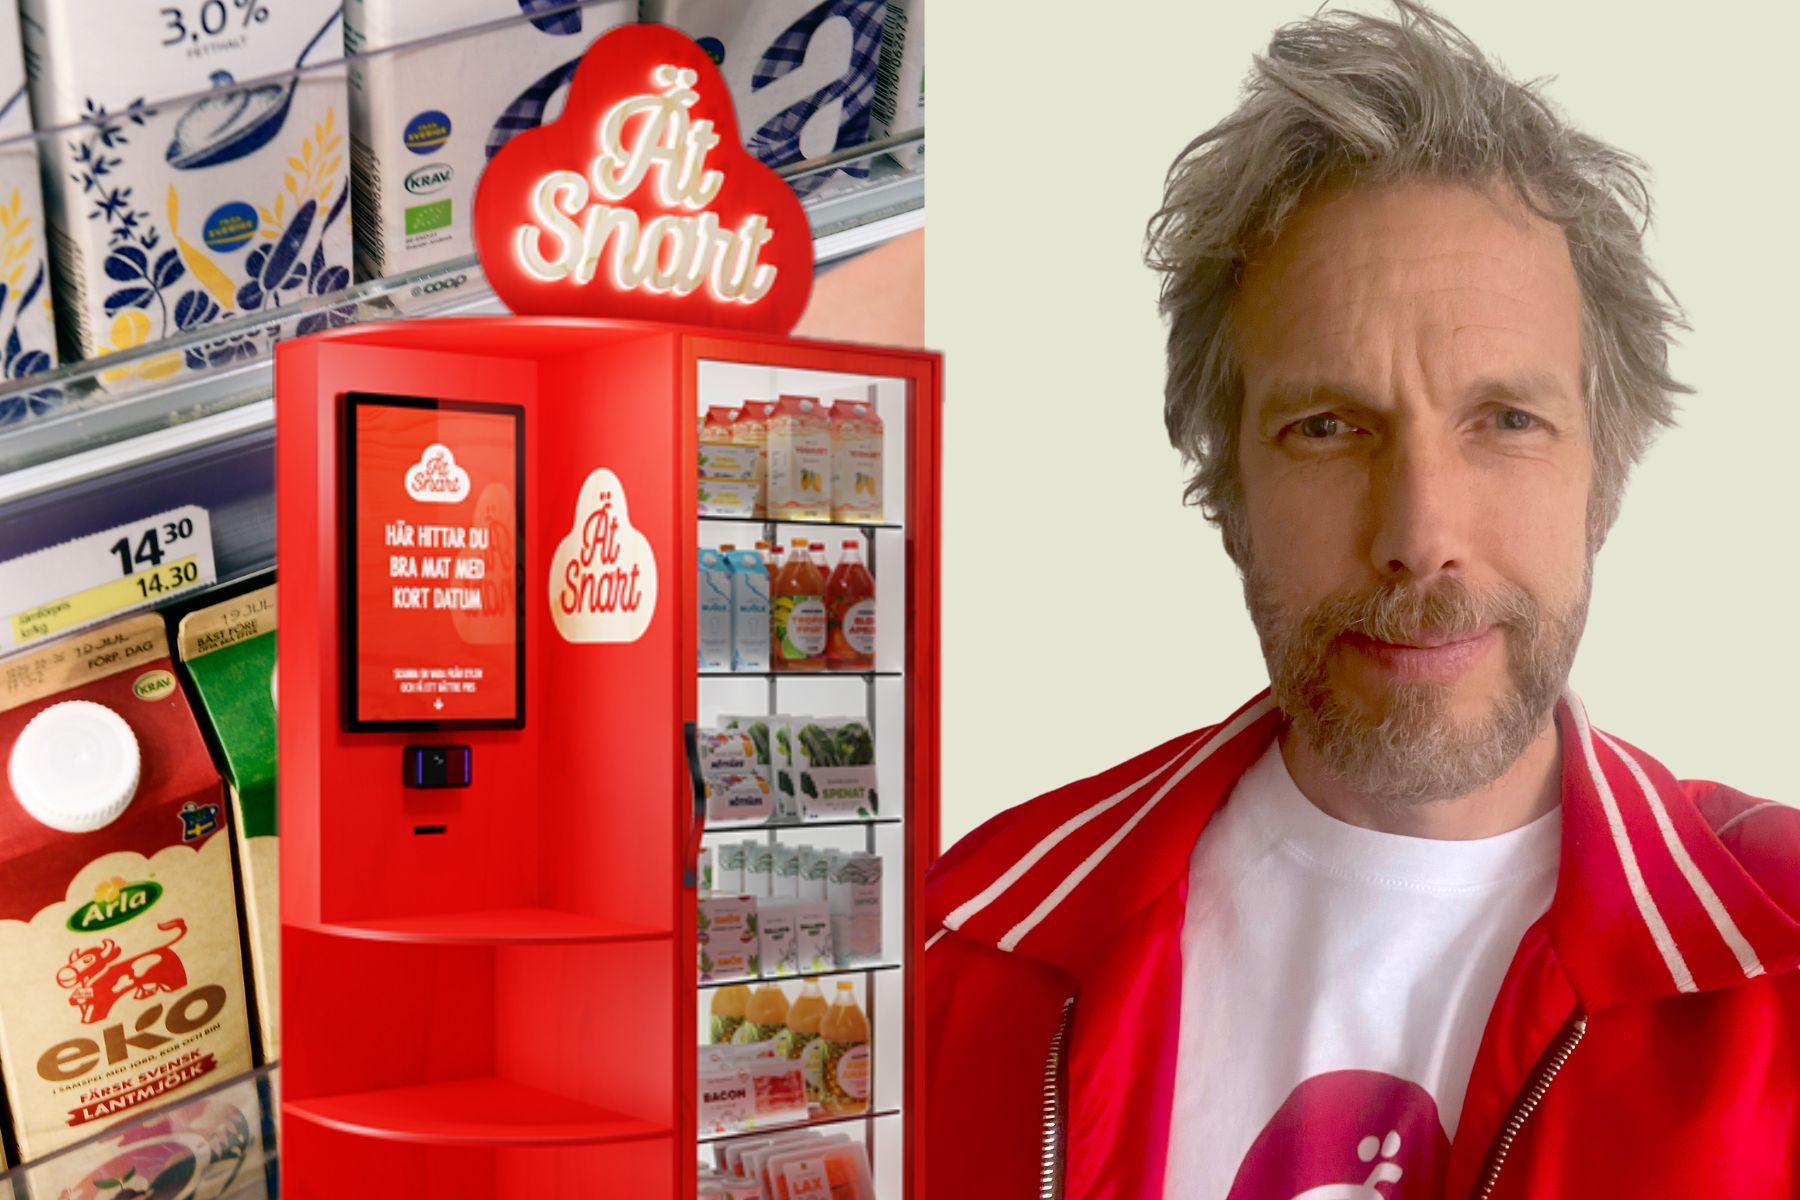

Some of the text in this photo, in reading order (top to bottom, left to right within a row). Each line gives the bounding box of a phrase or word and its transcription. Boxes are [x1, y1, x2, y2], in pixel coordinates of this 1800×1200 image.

[592, 64, 725, 208] Ät
[410, 170, 451, 189] KRAV
[515, 170, 778, 303] Snart
[412, 472, 461, 493] Snart
[385, 520, 489, 550] HÄR HITTAR DU
[580, 491, 621, 568] Ät
[137, 560, 199, 598] 14.30
[390, 556, 486, 580] BRA MAT MED
[392, 587, 483, 610] KORT DATUM
[560, 559, 642, 615] Snart
[125, 640, 155, 658] DAG
[138, 677, 174, 696] KRAV
[822, 786, 866, 800] SPENAT
[82, 890, 147, 927] Arla
[36, 984, 227, 1082] eko
[106, 1067, 127, 1078] MED
[159, 1044, 180, 1058] KOR
[182, 1032, 203, 1047] OCH
[204, 1022, 222, 1037] BIN
[80, 1046, 202, 1104] FÄRSK SVENSK
[83, 1063, 203, 1121] LANTMJÖLK
[704, 1087, 747, 1104] BACON
[792, 1175, 824, 1196] LAX
